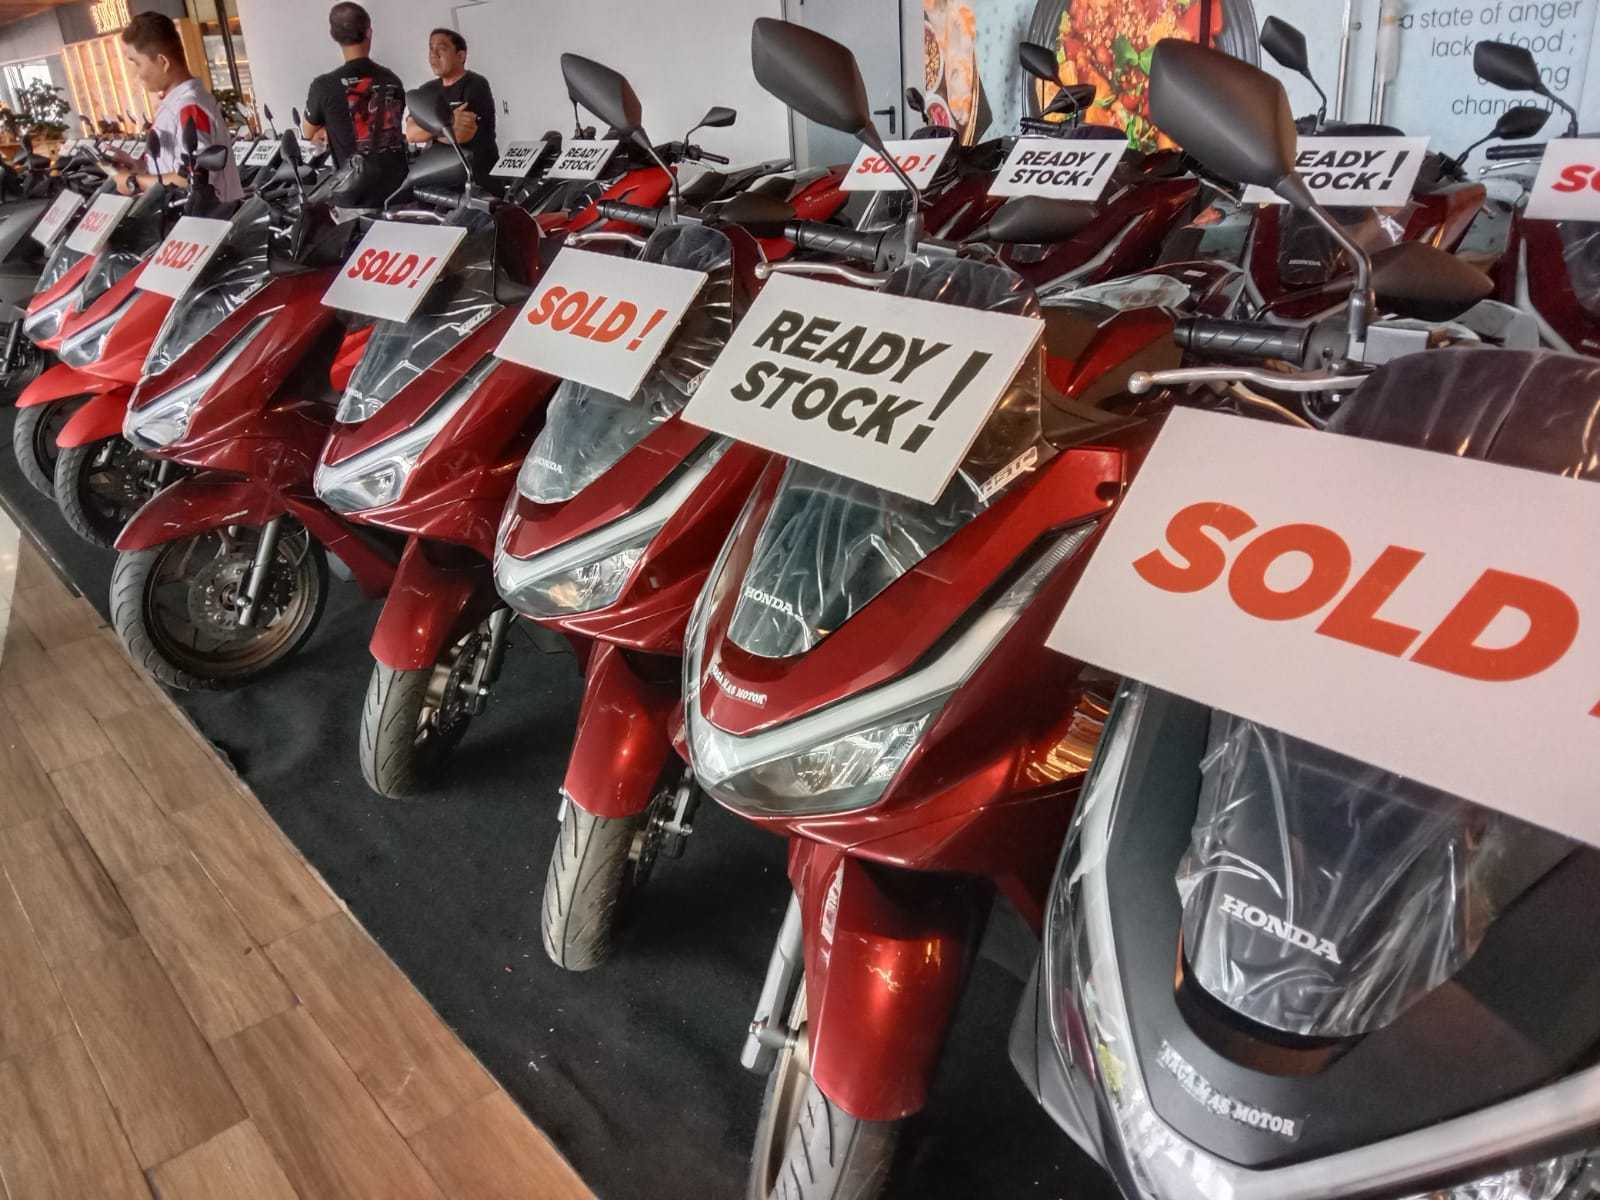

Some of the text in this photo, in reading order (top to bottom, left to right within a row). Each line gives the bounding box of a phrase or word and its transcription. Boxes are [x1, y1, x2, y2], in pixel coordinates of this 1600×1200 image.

[1400, 0, 1582, 30] a state of anger
[1432, 36, 1475, 57] lack
[504, 147, 533, 158] READY
[565, 147, 600, 158] READY
[1015, 150, 1095, 167] READY
[1295, 150, 1386, 168] EADY
[1302, 150, 1411, 191] OCK!
[155, 239, 209, 271] SOLD!
[347, 248, 436, 289] SOLD!
[527, 286, 669, 352] SOLD!
[752, 309, 954, 384] READY
[744, 585, 796, 616] HONDA
[1131, 502, 1600, 717] SOLD
[736, 687, 765, 705] MOTOR
[1219, 893, 1342, 965] HONDA
[1231, 1102, 1296, 1137] MOTOR
